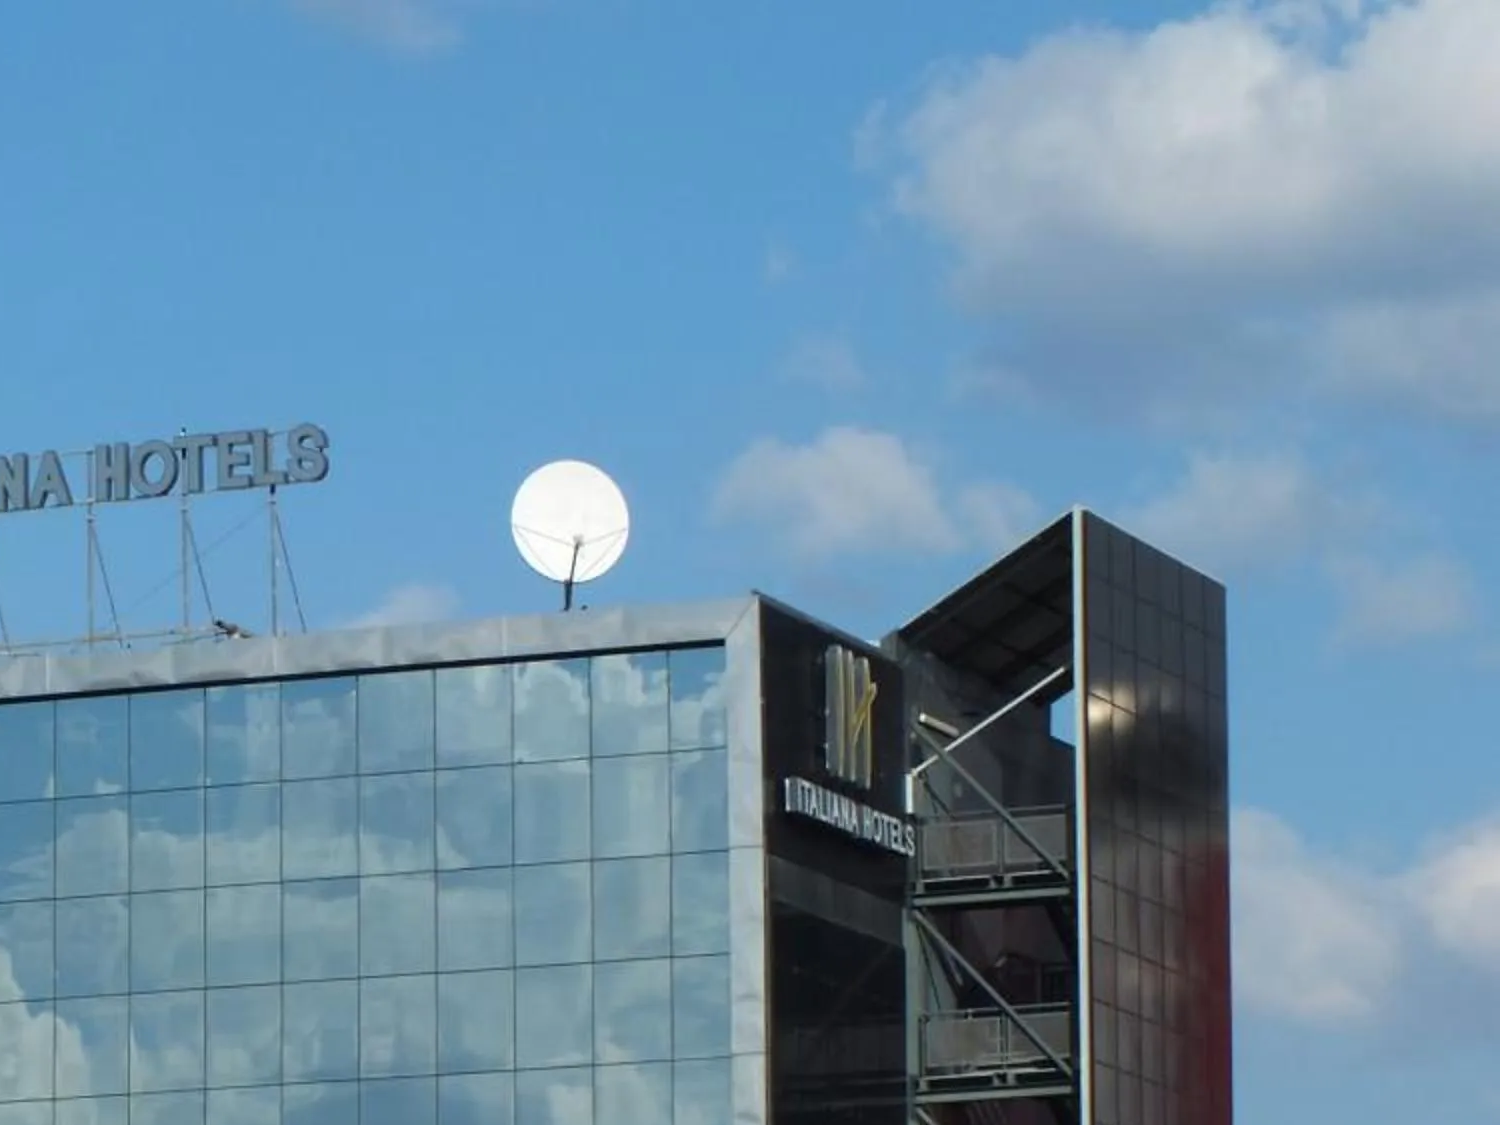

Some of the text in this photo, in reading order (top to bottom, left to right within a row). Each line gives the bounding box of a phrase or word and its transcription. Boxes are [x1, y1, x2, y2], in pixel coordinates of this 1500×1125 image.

[95, 423, 329, 501] HOTELS
[785, 776, 915, 857] ITALIANA HOTELS
